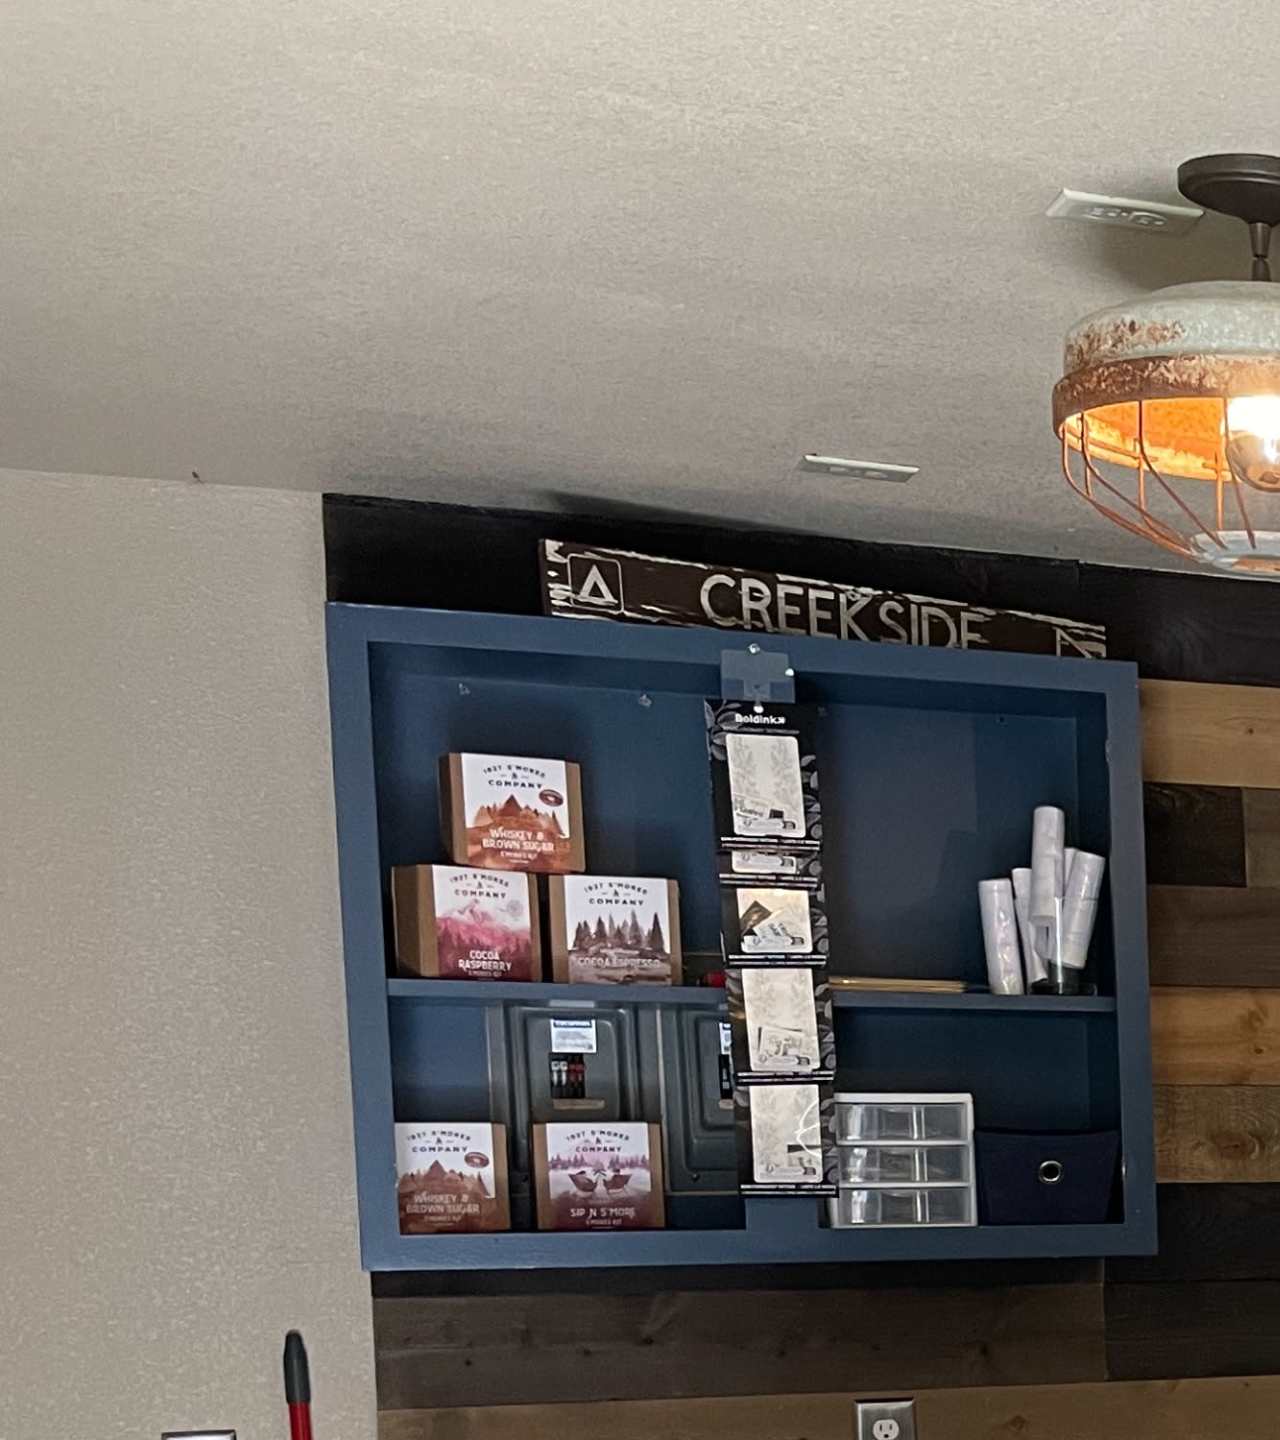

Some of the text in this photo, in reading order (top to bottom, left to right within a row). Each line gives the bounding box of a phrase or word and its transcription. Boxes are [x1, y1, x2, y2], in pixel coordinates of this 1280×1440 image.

[488, 779, 542, 789] COMPANY
[489, 827, 533, 841] WHISKEY
[482, 839, 554, 853] BROWN SUGAR
[455, 889, 506, 899] COMPANY
[588, 898, 643, 906] COMPANY
[469, 950, 500, 961] COCOA
[458, 959, 512, 972] RASPBERRY
[406, 1204, 480, 1214] BROWN SUGAR
[570, 1208, 586, 1217] SIP
